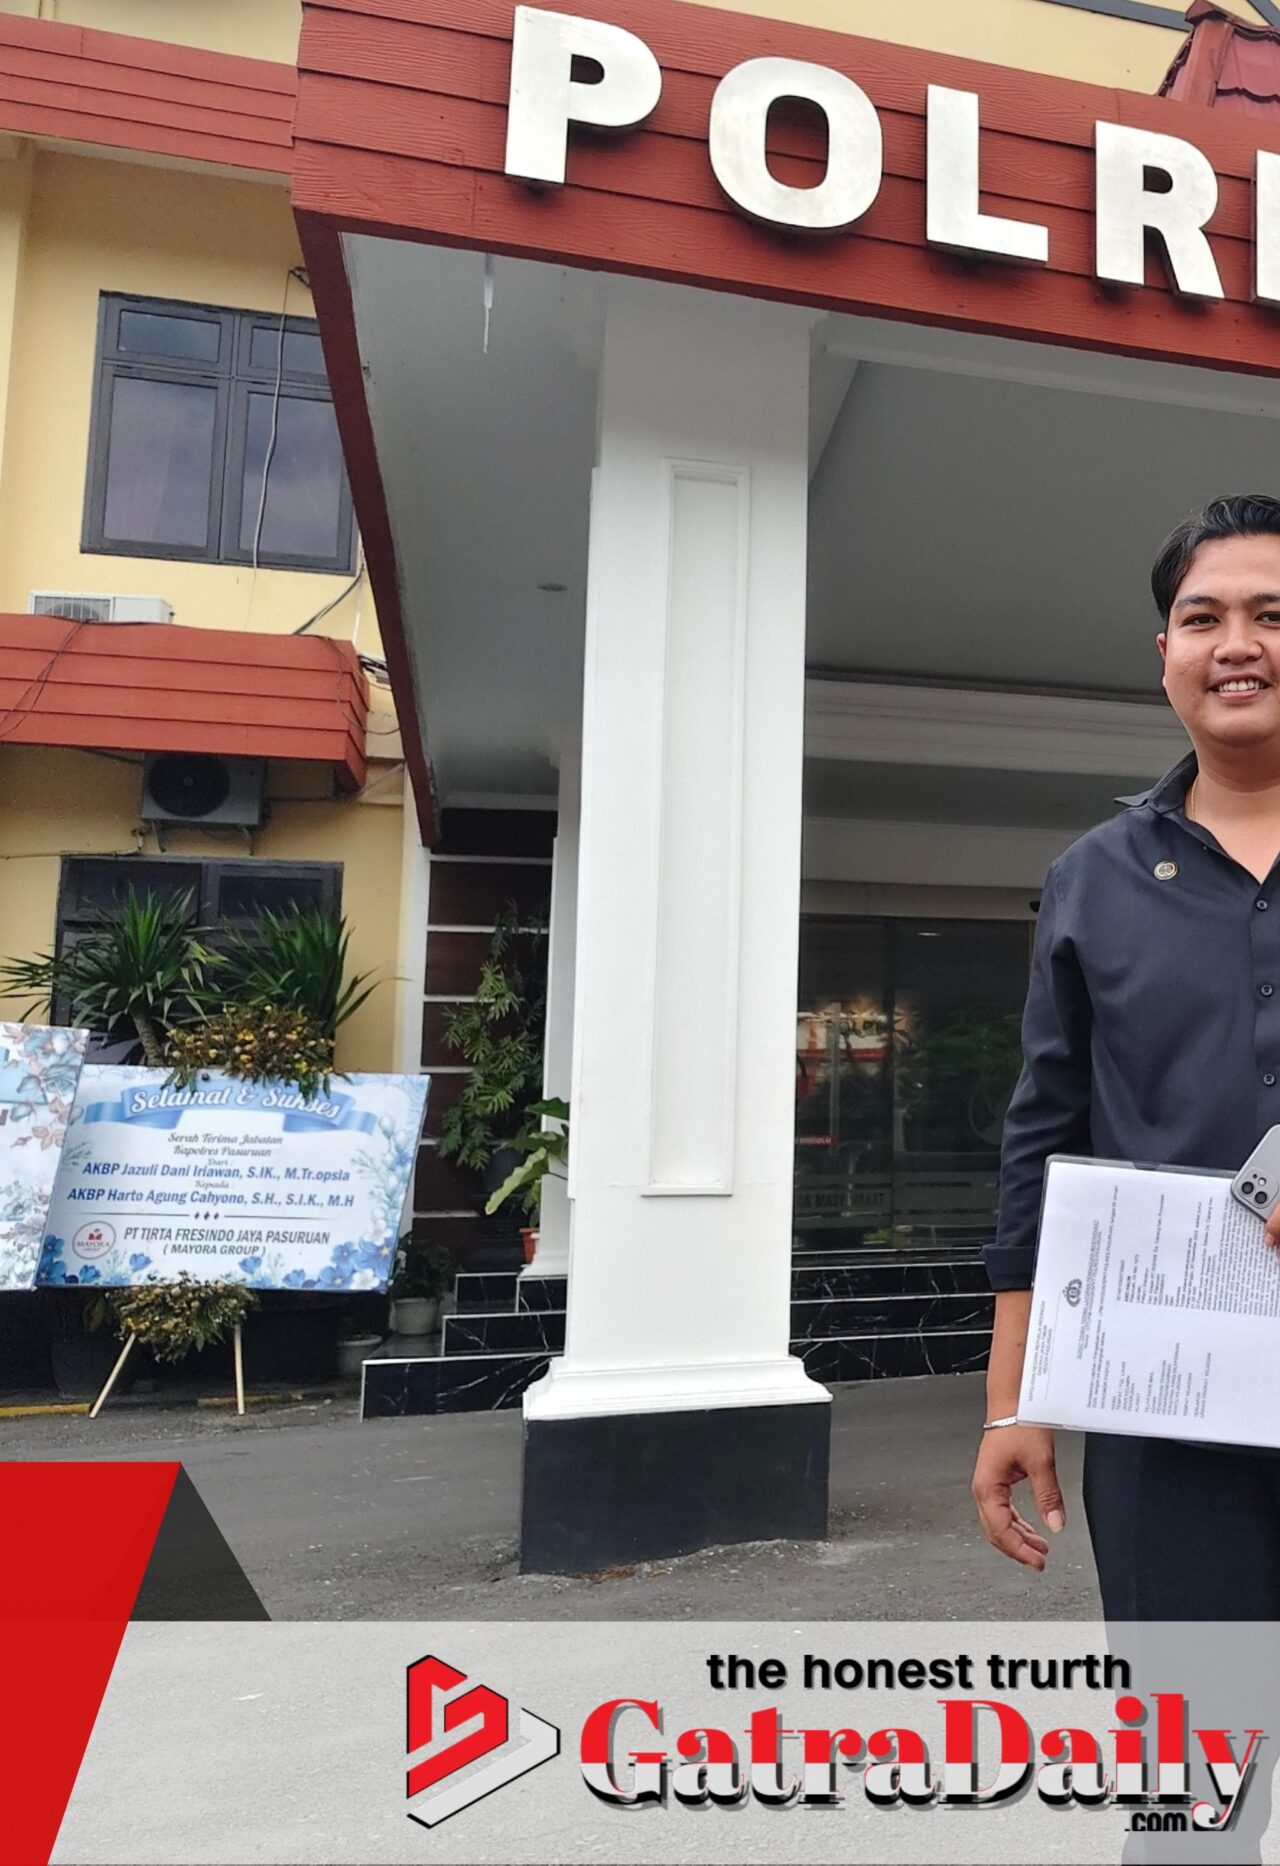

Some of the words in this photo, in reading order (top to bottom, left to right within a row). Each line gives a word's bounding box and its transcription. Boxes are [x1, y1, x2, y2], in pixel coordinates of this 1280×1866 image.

[131, 1087, 230, 1113] Selamat
[235, 1086, 256, 1105] &
[168, 1132, 199, 1144] Serah
[202, 1133, 238, 1144] Terima
[239, 1134, 283, 1146] Jabatan
[174, 1145, 219, 1157] Kapolres
[221, 1146, 272, 1157] Pasuruan
[82, 1162, 120, 1175] AKBP
[121, 1163, 158, 1176] Jazuli
[160, 1164, 190, 1177] Dani
[193, 1165, 243, 1179] Iriawan,
[67, 1188, 105, 1201] AKBP
[107, 1189, 143, 1201] Harto
[146, 1190, 188, 1205] Agung
[190, 1190, 248, 1206] Cahyono,
[124, 1227, 140, 1240] PT
[141, 1227, 172, 1241] TIRTA
[175, 1228, 235, 1242] FRESINDO
[236, 1230, 262, 1242] JAYA
[265, 1230, 330, 1244] PASURUAN
[171, 1244, 217, 1255] MAYORA
[220, 1245, 259, 1256] GROUP
